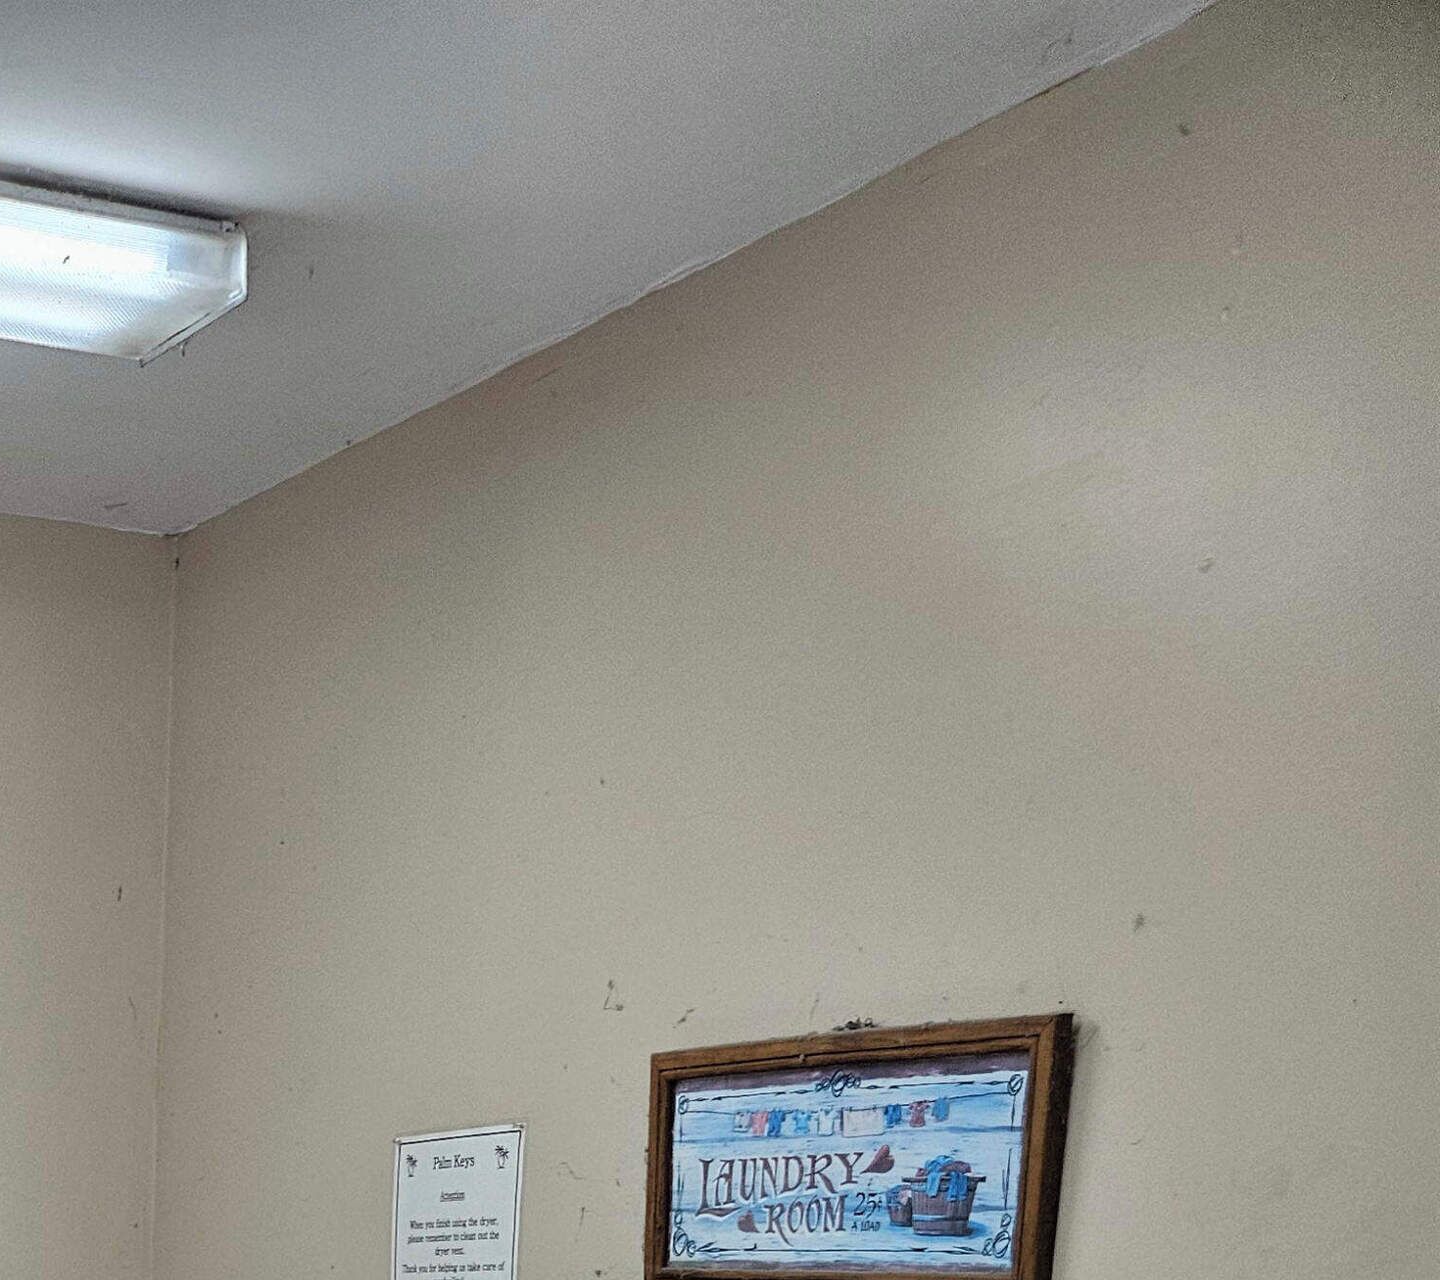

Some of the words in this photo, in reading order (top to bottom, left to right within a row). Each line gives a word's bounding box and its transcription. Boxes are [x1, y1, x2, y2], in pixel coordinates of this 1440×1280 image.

[433, 1156, 452, 1169] Palm
[453, 1153, 475, 1169] Keys
[695, 1152, 863, 1217] LAUNDRY
[764, 1194, 848, 1247] ROOM
